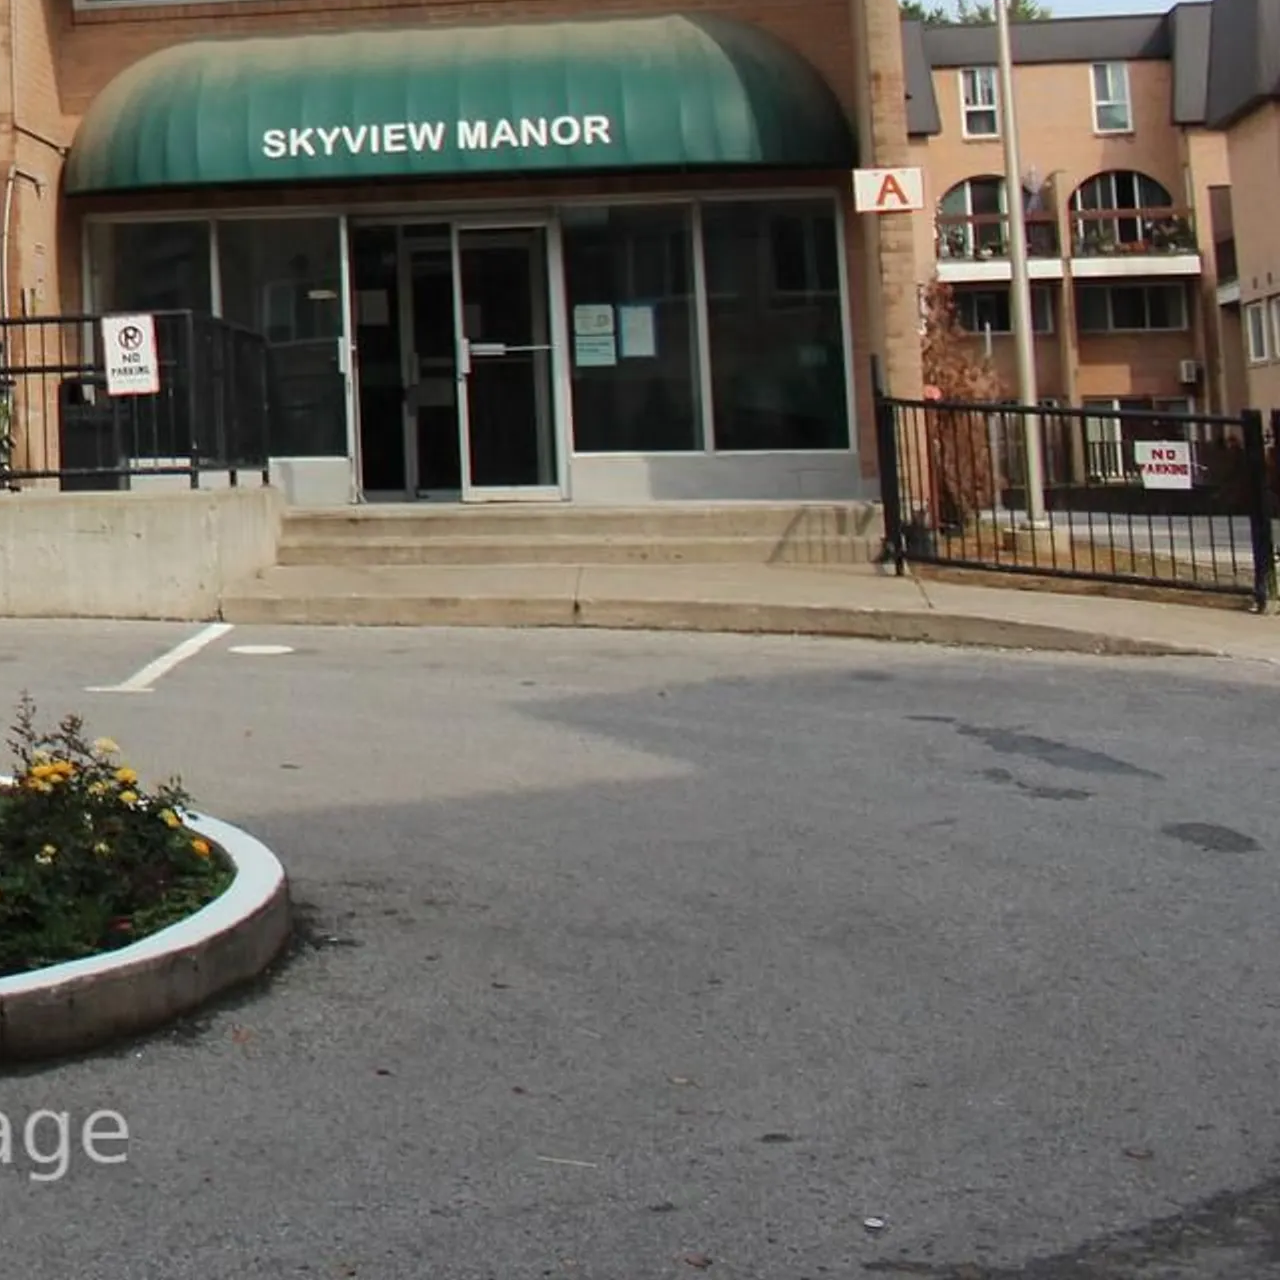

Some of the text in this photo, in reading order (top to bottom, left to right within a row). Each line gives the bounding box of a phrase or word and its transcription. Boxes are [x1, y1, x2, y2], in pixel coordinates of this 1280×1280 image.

[262, 115, 611, 158] SKYVIEW MANOR
[876, 174, 908, 206] A
[121, 352, 141, 363] NO
[1151, 449, 1175, 460] NO
